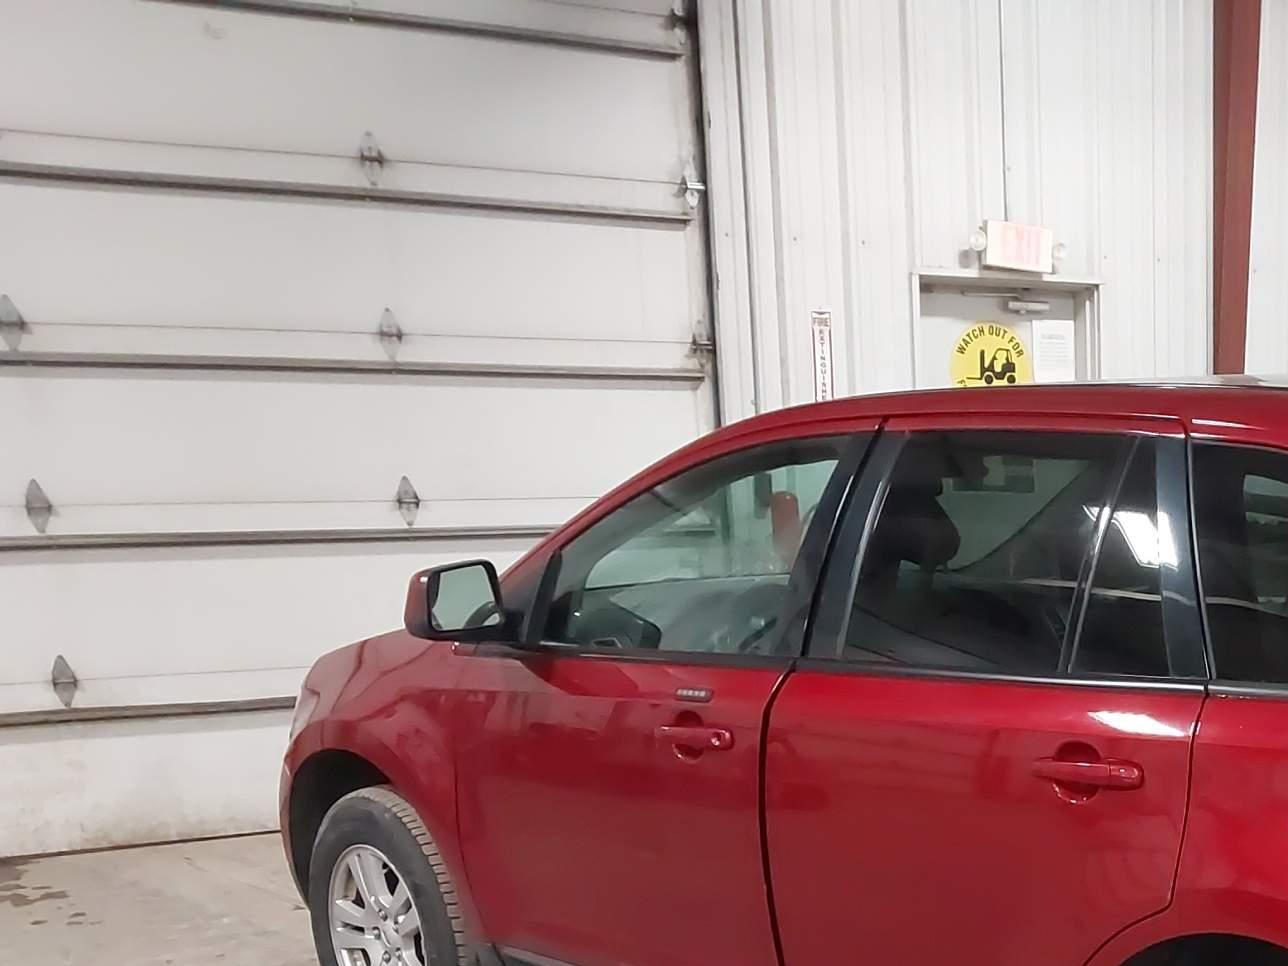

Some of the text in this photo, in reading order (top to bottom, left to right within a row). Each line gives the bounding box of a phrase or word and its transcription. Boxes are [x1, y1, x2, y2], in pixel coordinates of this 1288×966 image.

[819, 328, 828, 401] EXTINGUISHE
[955, 325, 986, 355] WATCH
[988, 324, 1009, 340] OUT
[1007, 335, 1025, 358] FOR
